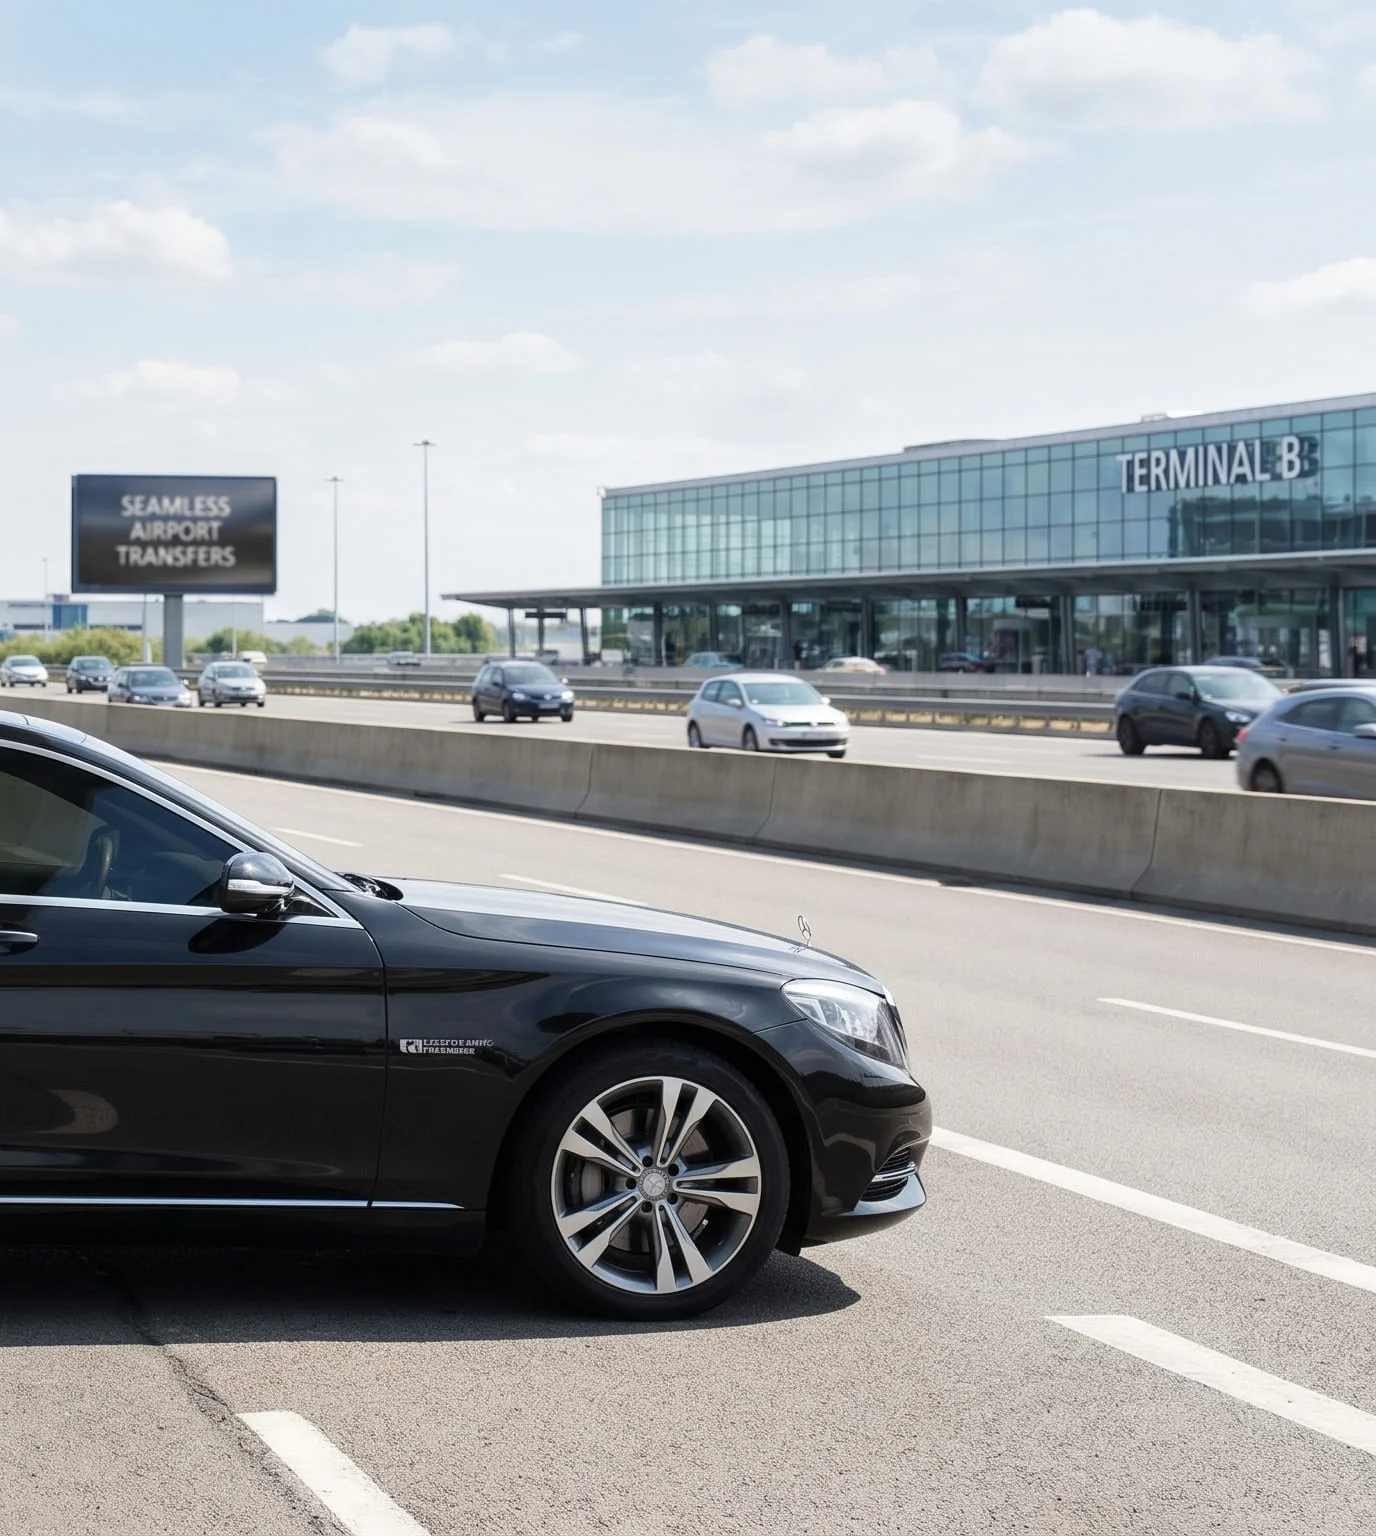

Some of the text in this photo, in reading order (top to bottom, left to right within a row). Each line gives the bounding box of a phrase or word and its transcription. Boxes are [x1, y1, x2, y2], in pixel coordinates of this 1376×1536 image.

[1115, 435, 1301, 494] TERMINAL B
[120, 495, 232, 518] SEAMLESS
[129, 520, 223, 542] AIRPORT
[115, 545, 237, 568] TRANSFERS
